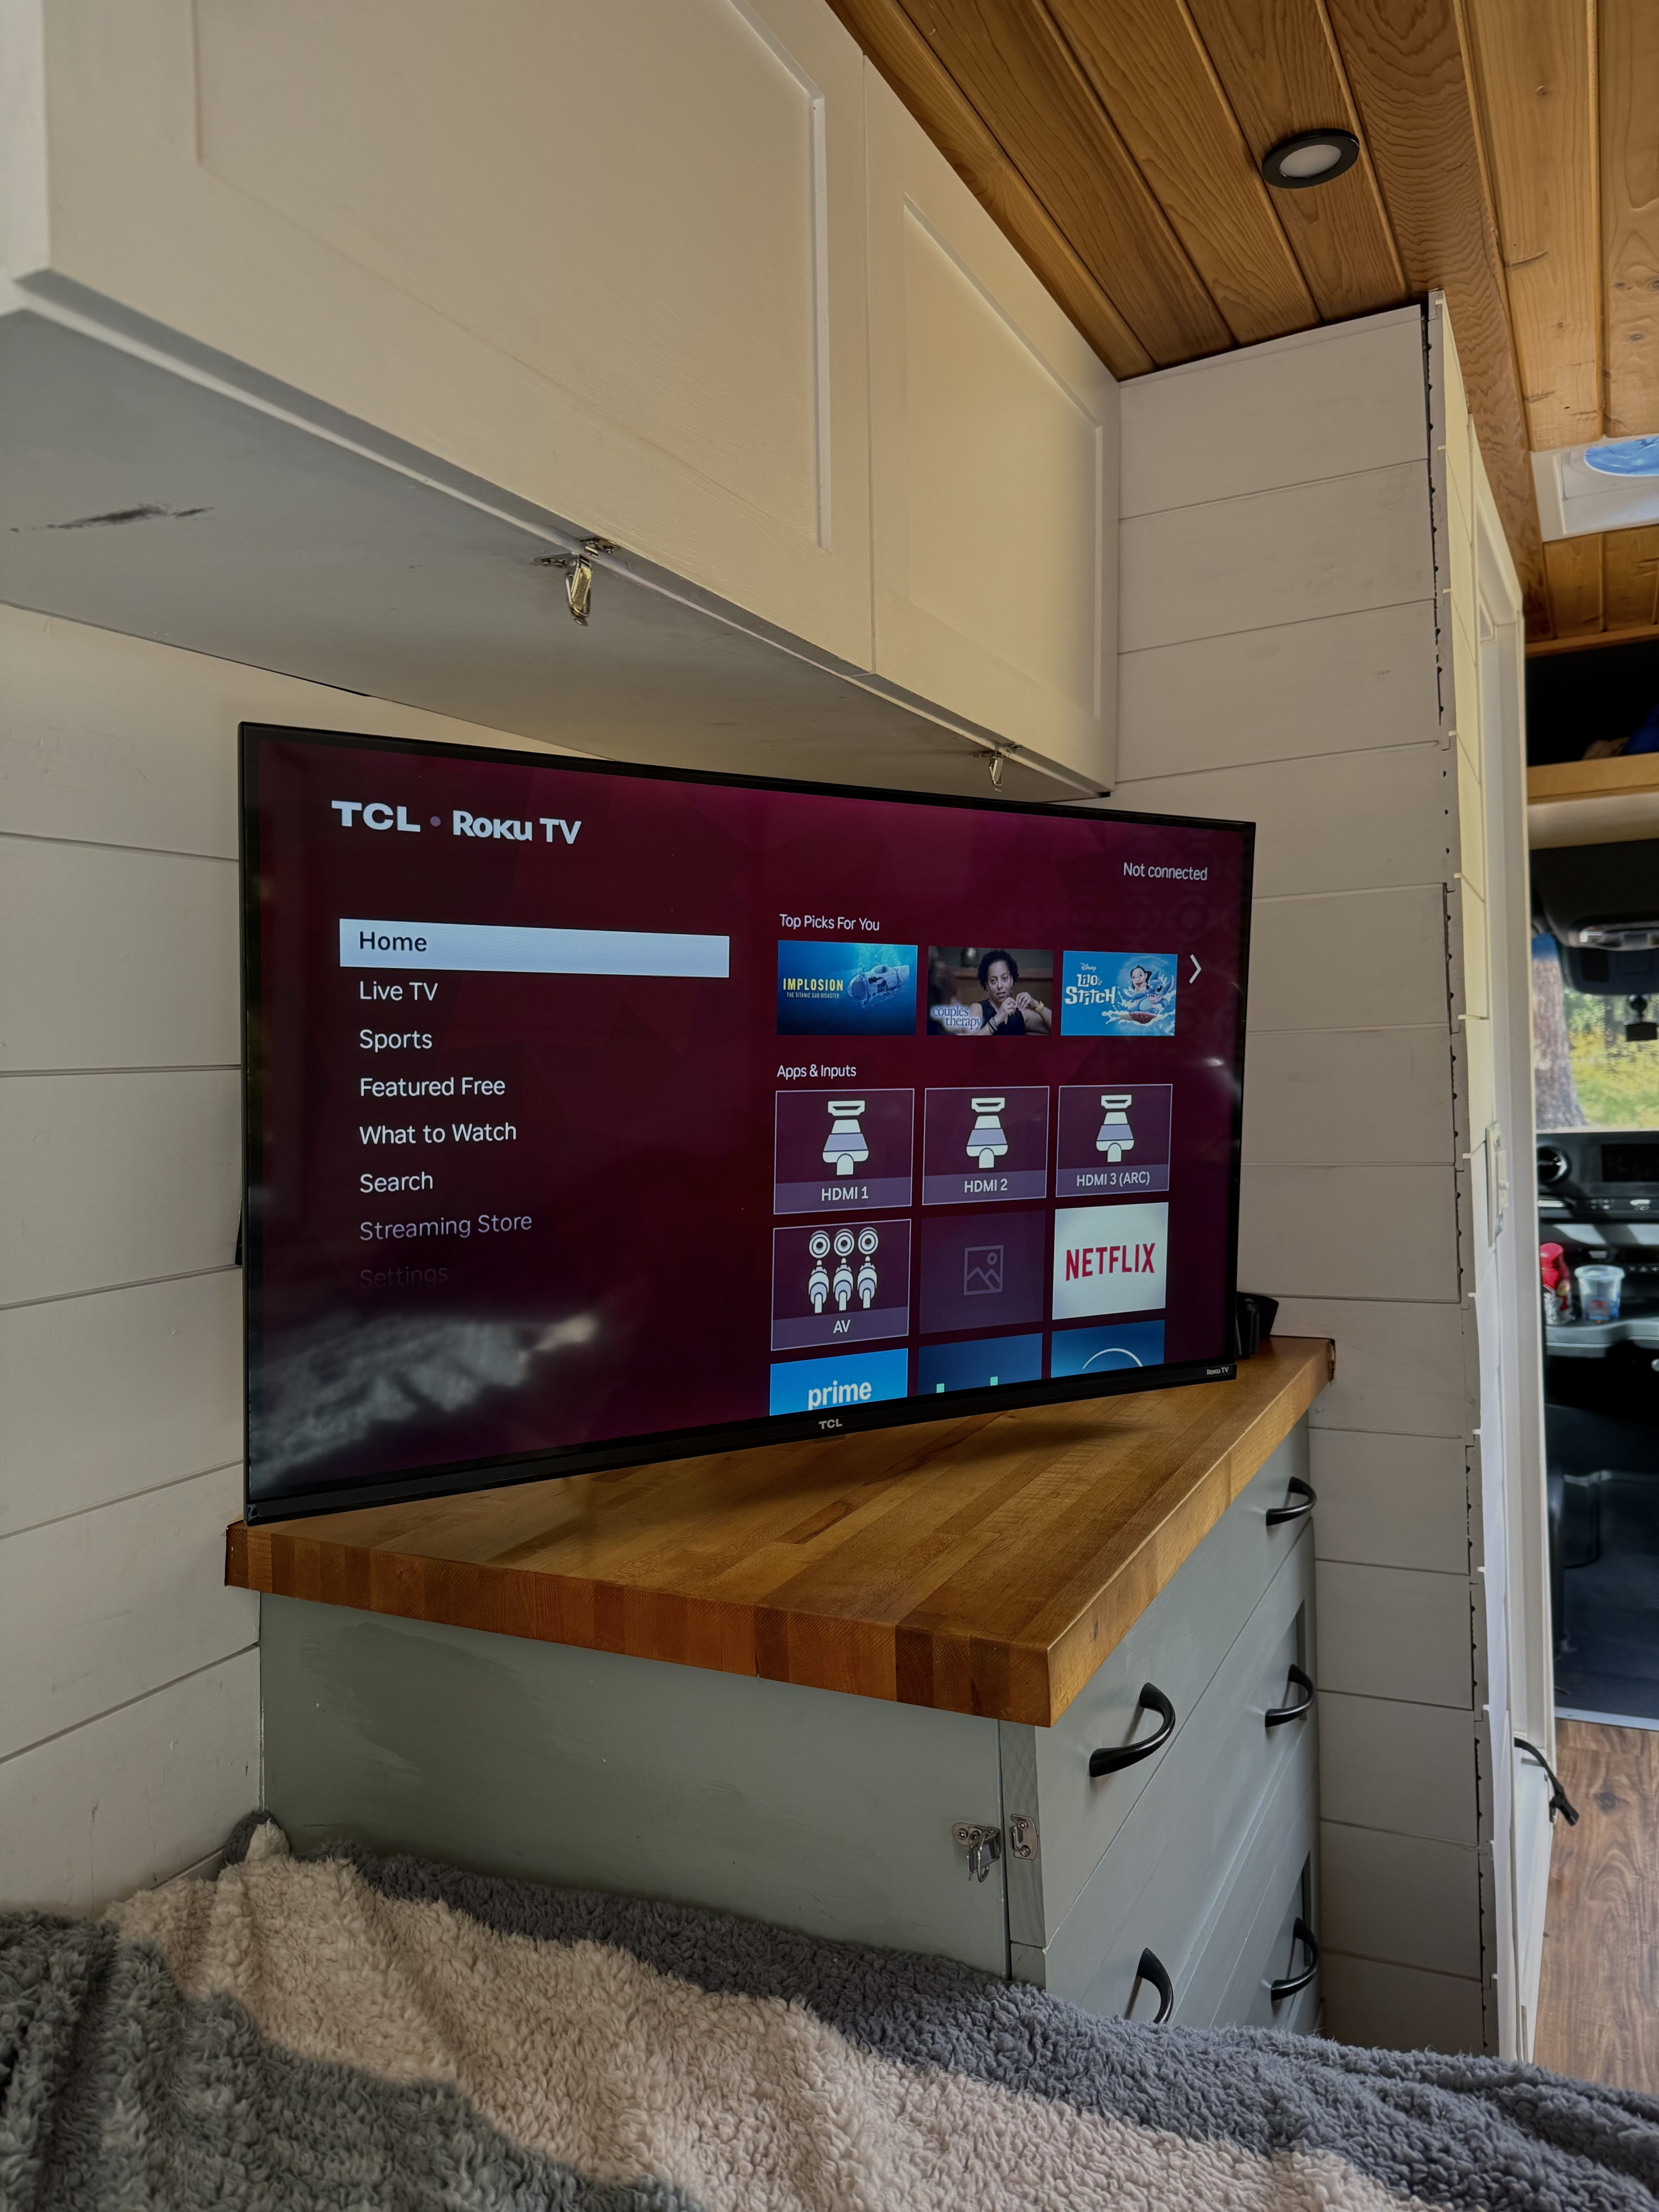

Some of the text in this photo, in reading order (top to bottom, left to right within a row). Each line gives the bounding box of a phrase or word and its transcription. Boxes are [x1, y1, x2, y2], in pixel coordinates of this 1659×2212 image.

[331, 800, 582, 844] TCL Roku TV
[1124, 862, 1208, 880] Not connected
[779, 914, 880, 931] Top Picks For You
[359, 931, 427, 952] Home
[360, 981, 438, 1001] Live TV
[783, 978, 843, 991] IMPLOSION
[932, 1005, 969, 1020] couples
[946, 1016, 983, 1030] therapy
[359, 1030, 432, 1052] Sports
[777, 1064, 857, 1080] Apps & Inputs
[360, 1077, 505, 1096] Featured Free
[359, 1122, 517, 1144] What to Watch
[360, 1171, 433, 1193] Search
[964, 1178, 1008, 1193] HDMI 2
[1076, 1171, 1150, 1187] HDMI 3 (ARC)
[821, 1186, 869, 1201] HDMI 1
[360, 1215, 532, 1240] Streaming Store
[1065, 1243, 1155, 1281] NETFLIX
[360, 1266, 448, 1288] Settings
[833, 1319, 851, 1334] AV
[808, 1380, 872, 1411] prime
[818, 1418, 843, 1430] TCL
